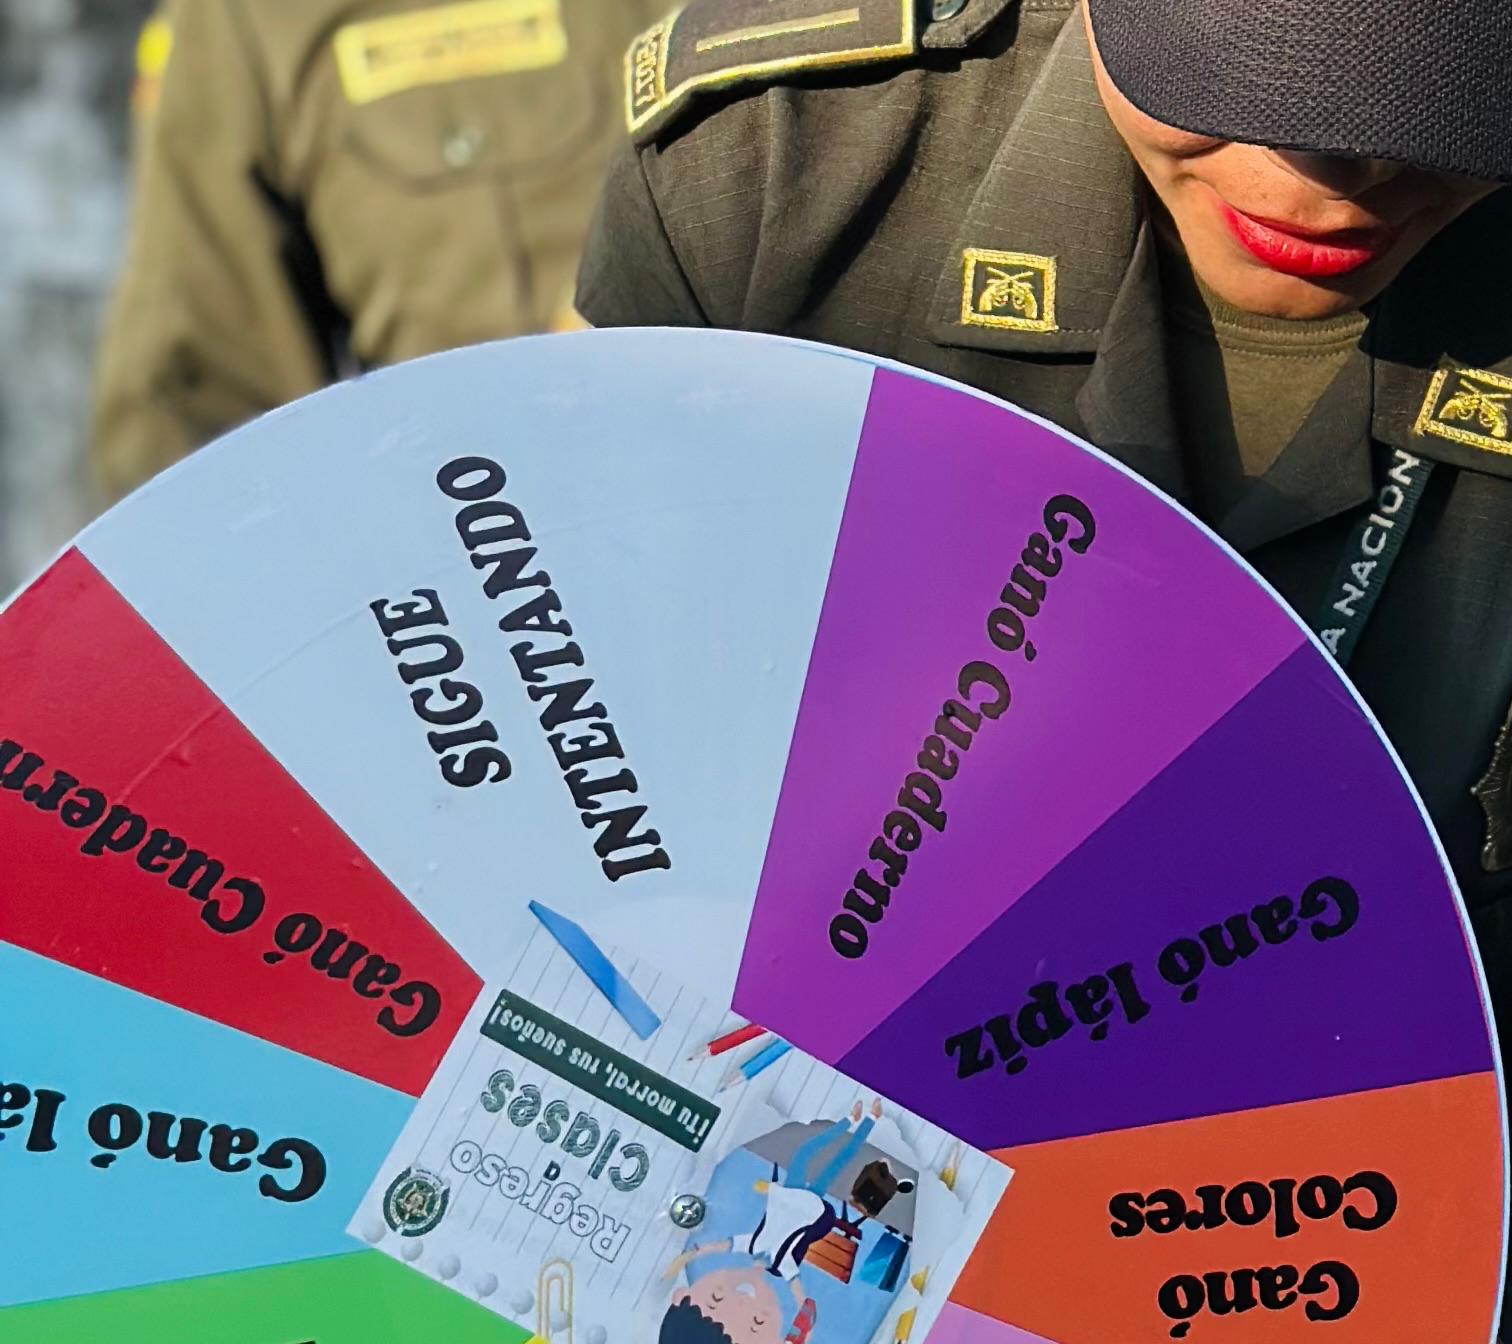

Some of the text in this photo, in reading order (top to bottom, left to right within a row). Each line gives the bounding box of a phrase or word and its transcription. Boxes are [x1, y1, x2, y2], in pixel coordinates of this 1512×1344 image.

[369, 589, 512, 787] SIGUE
[436, 456, 671, 882] INTENTANDO
[828, 494, 1096, 960] Ganó Cuaderno
[263, 912, 442, 1037] Ganó
[945, 876, 1360, 1080] Ganó lápiz
[567, 1046, 602, 1076] tus
[604, 1060, 677, 1115] morral,
[88, 1103, 327, 1203] Ganó
[480, 1068, 651, 1193] Clases
[543, 1160, 561, 1181] a
[450, 1140, 631, 1263] Regreso
[1108, 1170, 1398, 1238] Colores
[1157, 1260, 1361, 1338] Ganó
